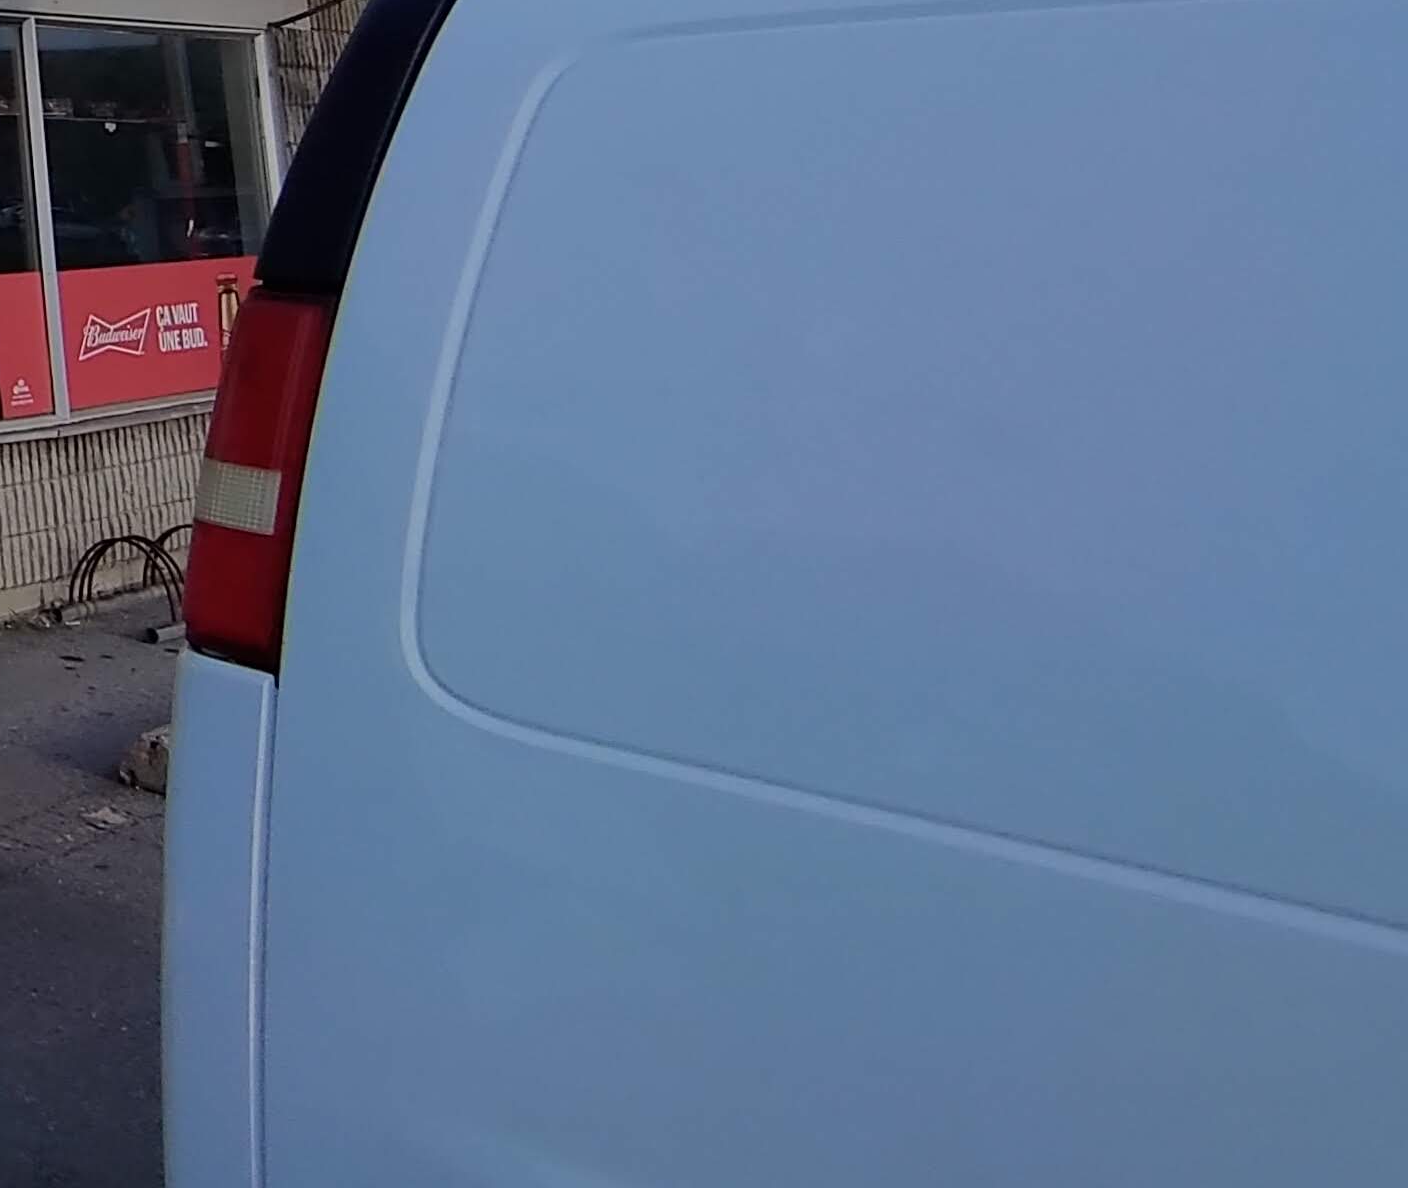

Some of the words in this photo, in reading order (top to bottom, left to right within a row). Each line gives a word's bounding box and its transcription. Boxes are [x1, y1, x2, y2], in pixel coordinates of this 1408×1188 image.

[83, 323, 147, 348] Budweiser
[156, 306, 172, 331] ÇA
[172, 303, 199, 325] VAUT
[158, 330, 182, 353] UNE
[182, 327, 208, 349] BUD.
